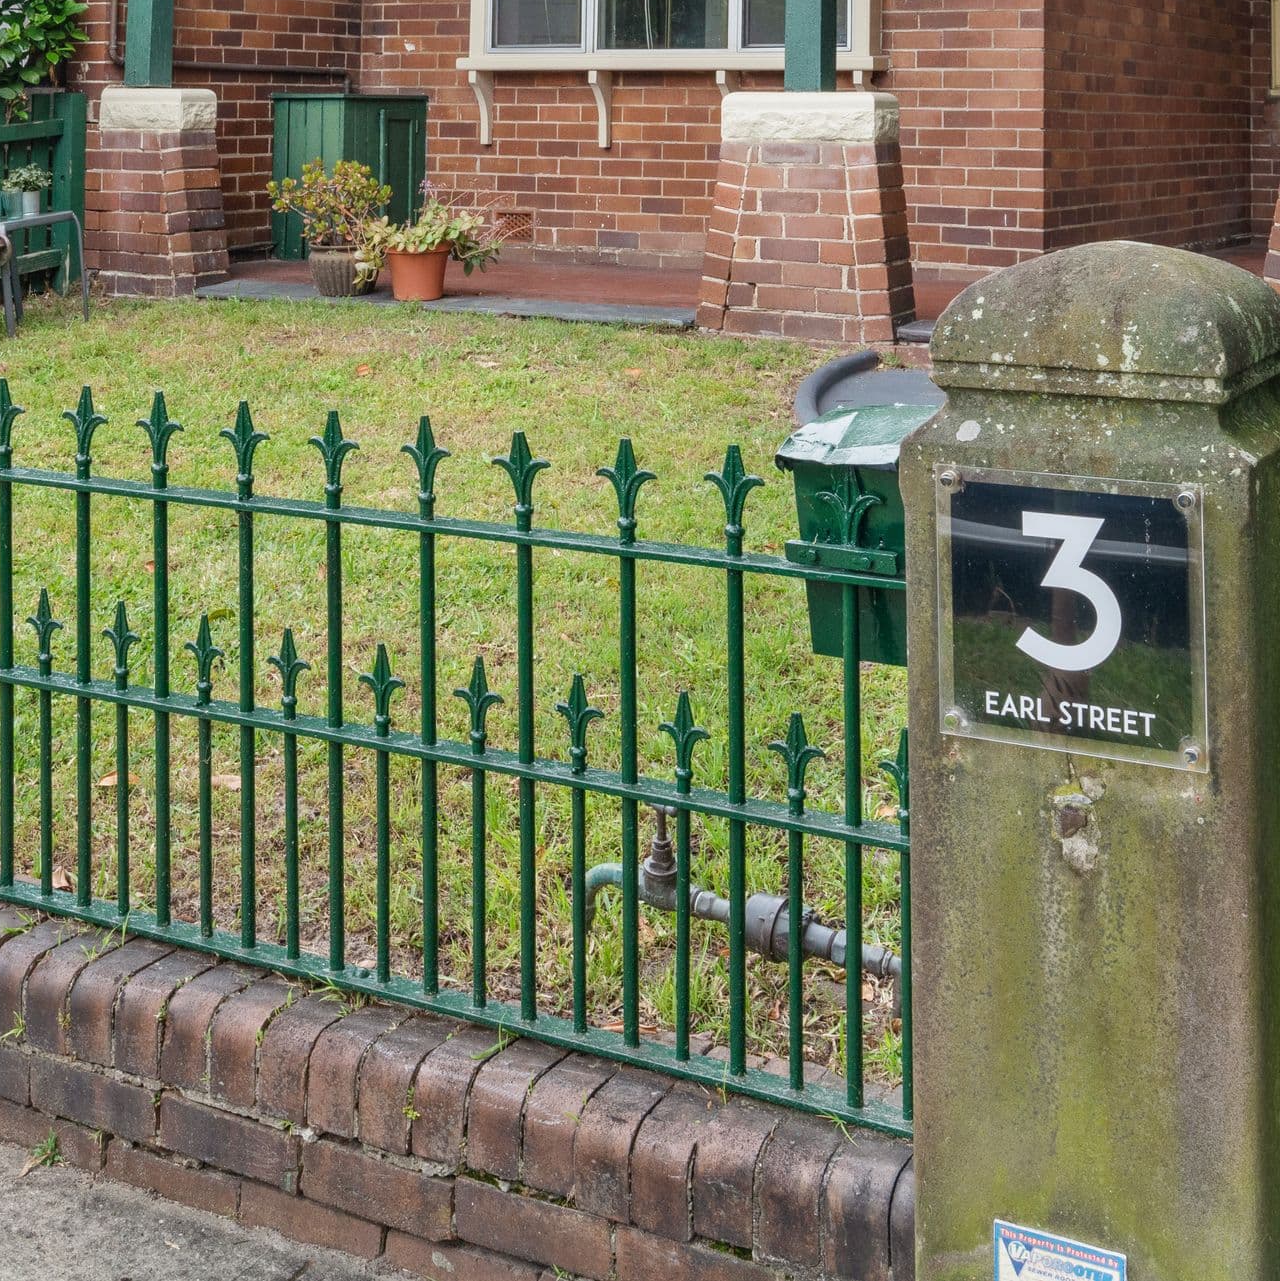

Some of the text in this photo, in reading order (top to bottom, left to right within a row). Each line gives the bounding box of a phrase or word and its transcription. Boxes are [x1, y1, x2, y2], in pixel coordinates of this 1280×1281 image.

[1016, 510, 1122, 671] 3
[985, 690, 1156, 737] EARL STREET
[1001, 1228, 1016, 1239] This
[1019, 1232, 1054, 1251] Property
[1066, 1247, 1106, 1264] Protected
[1027, 1266, 1053, 1278] SEWER
